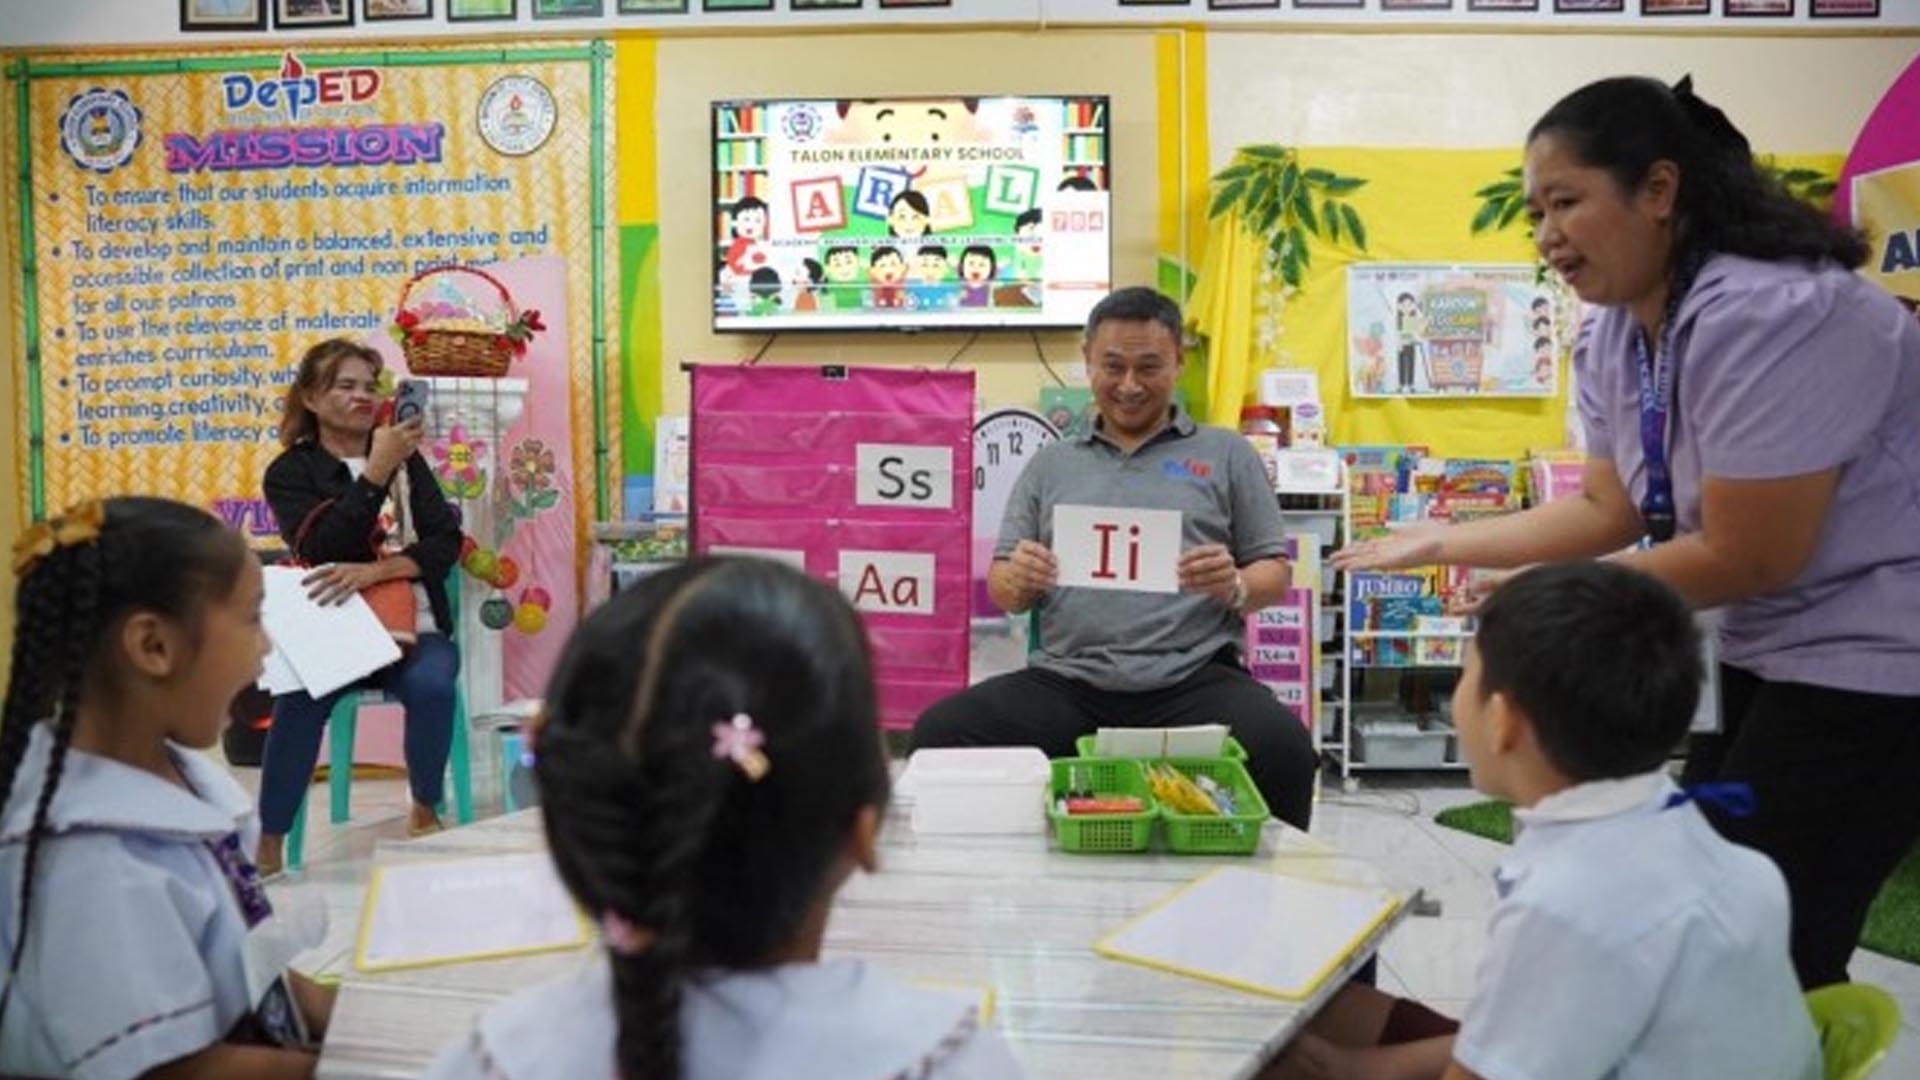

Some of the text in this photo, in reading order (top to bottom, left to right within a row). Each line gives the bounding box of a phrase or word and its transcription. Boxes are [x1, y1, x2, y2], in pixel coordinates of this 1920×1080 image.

[223, 66, 380, 121] DepED
[164, 124, 444, 172] MISSION
[791, 146, 1025, 163] TALON ELEMENTARY SCHOOL
[85, 173, 511, 206] To ensure that our students acquire information
[86, 212, 156, 235] literacy
[71, 239, 94, 260] To
[99, 239, 172, 261] develop
[178, 237, 210, 255] and
[218, 236, 291, 254] maintain
[403, 226, 500, 248] extensive
[510, 224, 547, 245] and
[73, 266, 163, 288] accessible
[171, 261, 256, 283] collection
[260, 258, 280, 278] of
[284, 258, 324, 281] print
[331, 256, 364, 275] and
[372, 260, 407, 274] non
[73, 289, 236, 315] for all our patrons
[75, 320, 98, 341] To
[104, 325, 134, 339] use
[141, 318, 169, 337] the
[175, 315, 263, 335] relevance
[268, 311, 287, 331] of
[76, 346, 157, 367] enriches
[77, 373, 99, 393] To
[105, 370, 172, 393] prompt
[80, 424, 100, 445] To
[108, 422, 185, 448] promote
[191, 420, 261, 443] literacy
[1008, 431, 1022, 455] 12
[986, 442, 1000, 466] 11
[877, 456, 933, 500] Ss
[975, 465, 985, 490] 0
[1091, 523, 1140, 581] Ii
[853, 563, 920, 607] Aa
[1356, 578, 1419, 600] JUMBO
